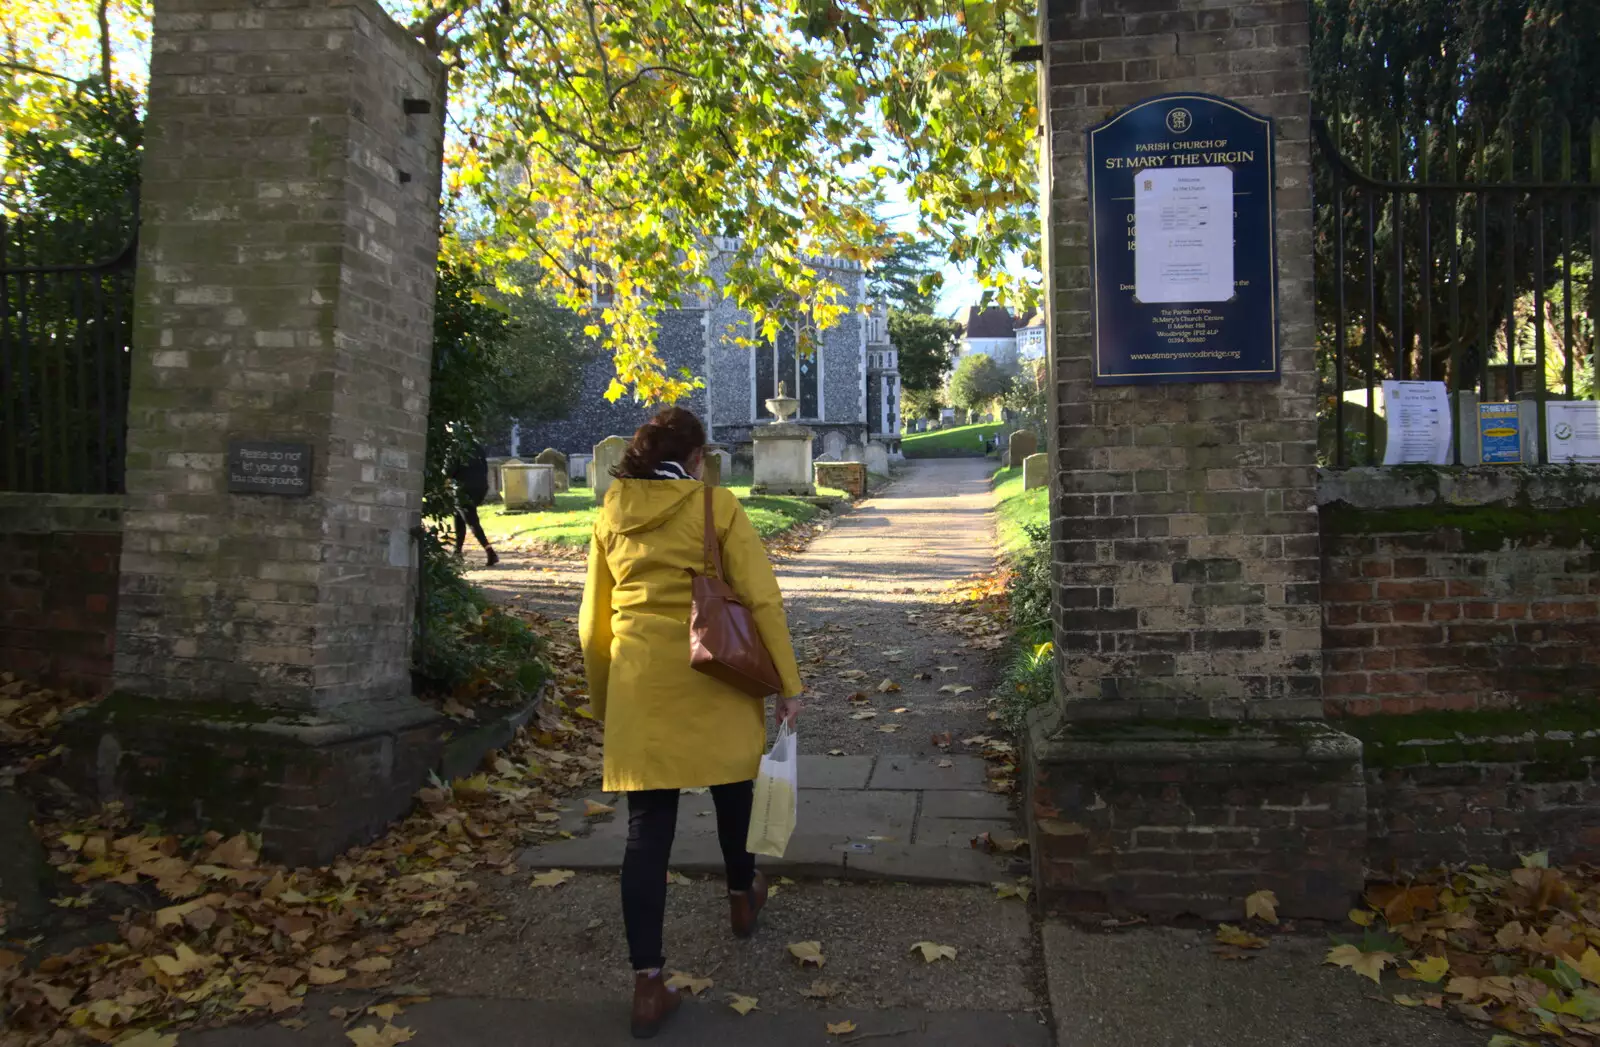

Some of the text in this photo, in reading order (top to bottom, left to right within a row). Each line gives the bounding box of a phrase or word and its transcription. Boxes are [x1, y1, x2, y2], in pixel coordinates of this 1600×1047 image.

[1136, 140, 1228, 151] PARISH CHURCH OF
[1126, 156, 1167, 168] MARY
[1171, 153, 1200, 166] THE
[1202, 151, 1254, 164] VIRGIN
[1130, 350, 1240, 360] www.stmaryswoodbridge.org
[256, 464, 278, 474] your
